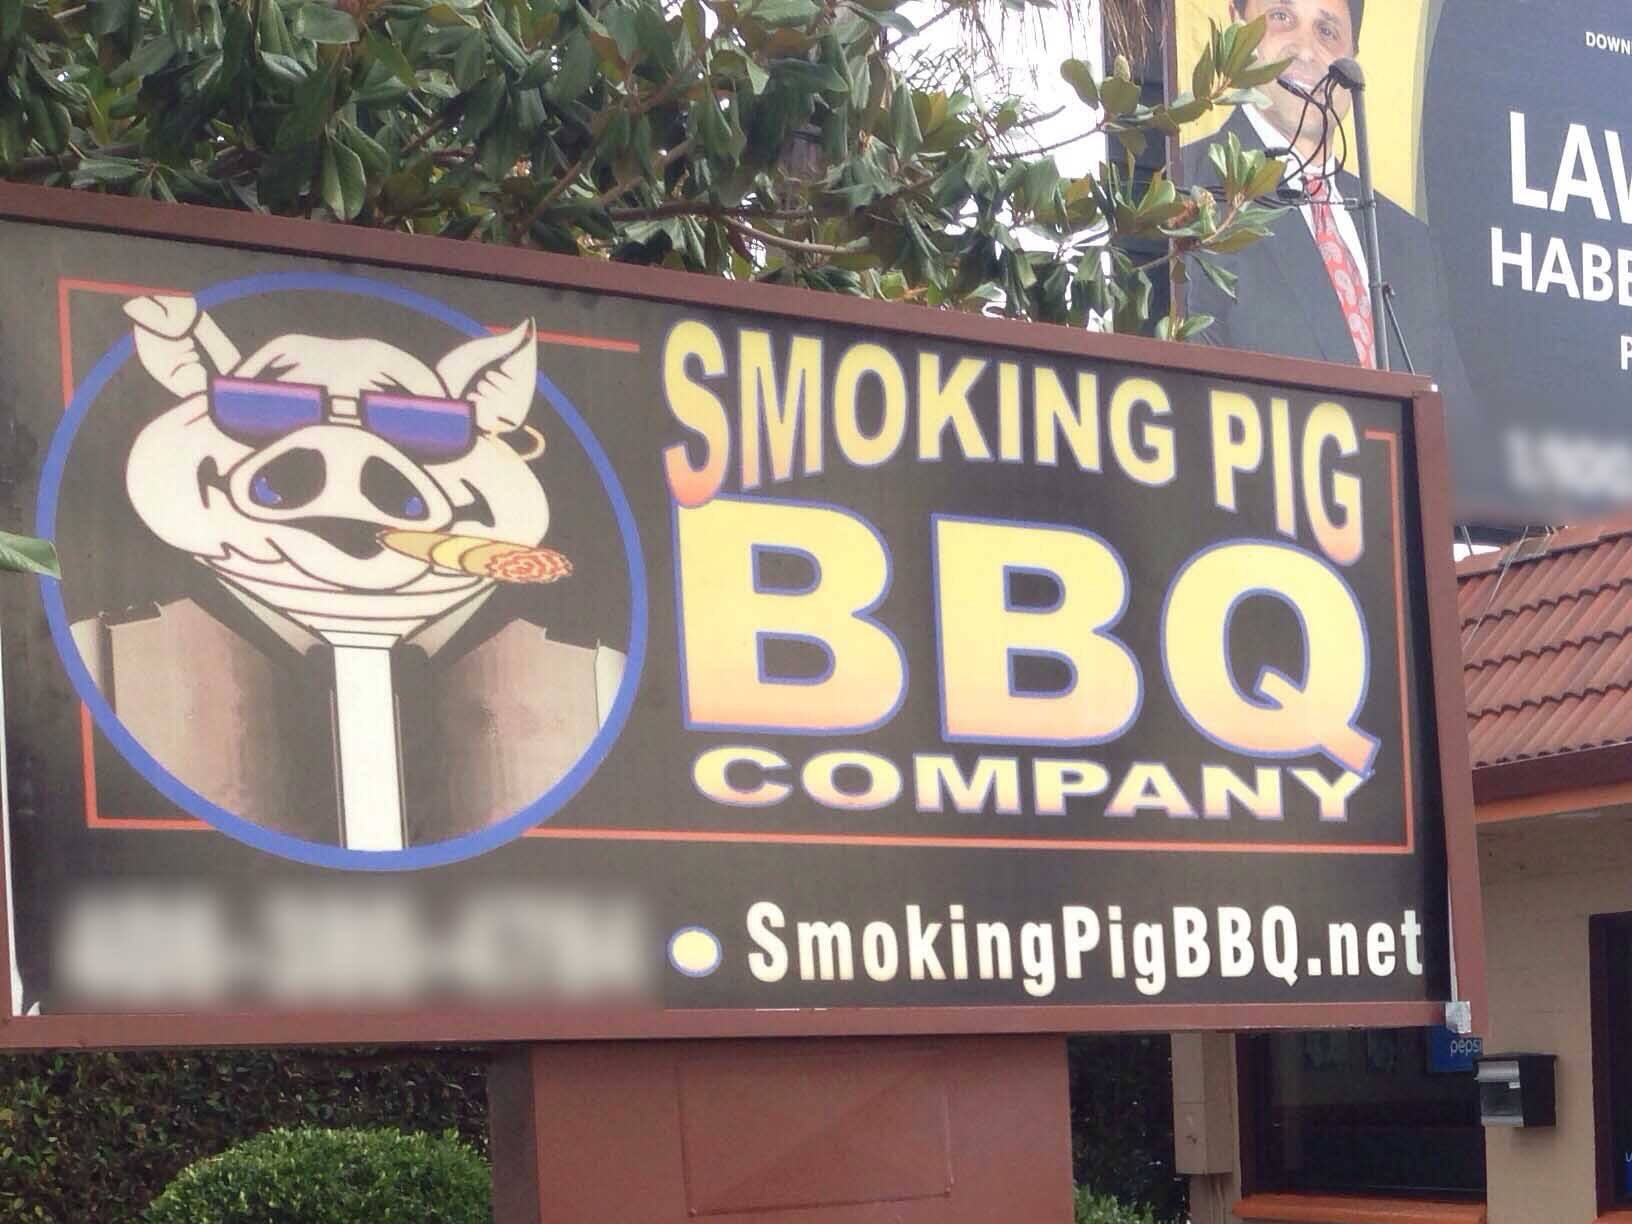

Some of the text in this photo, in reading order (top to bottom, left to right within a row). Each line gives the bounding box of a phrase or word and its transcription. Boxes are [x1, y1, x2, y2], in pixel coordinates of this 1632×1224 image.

[662, 317, 1366, 567] SMOKING PIG
[673, 491, 1382, 778] BBQ
[690, 745, 1376, 823] COMPANY
[745, 899, 1425, 997] SmokingPigBBQ.net
